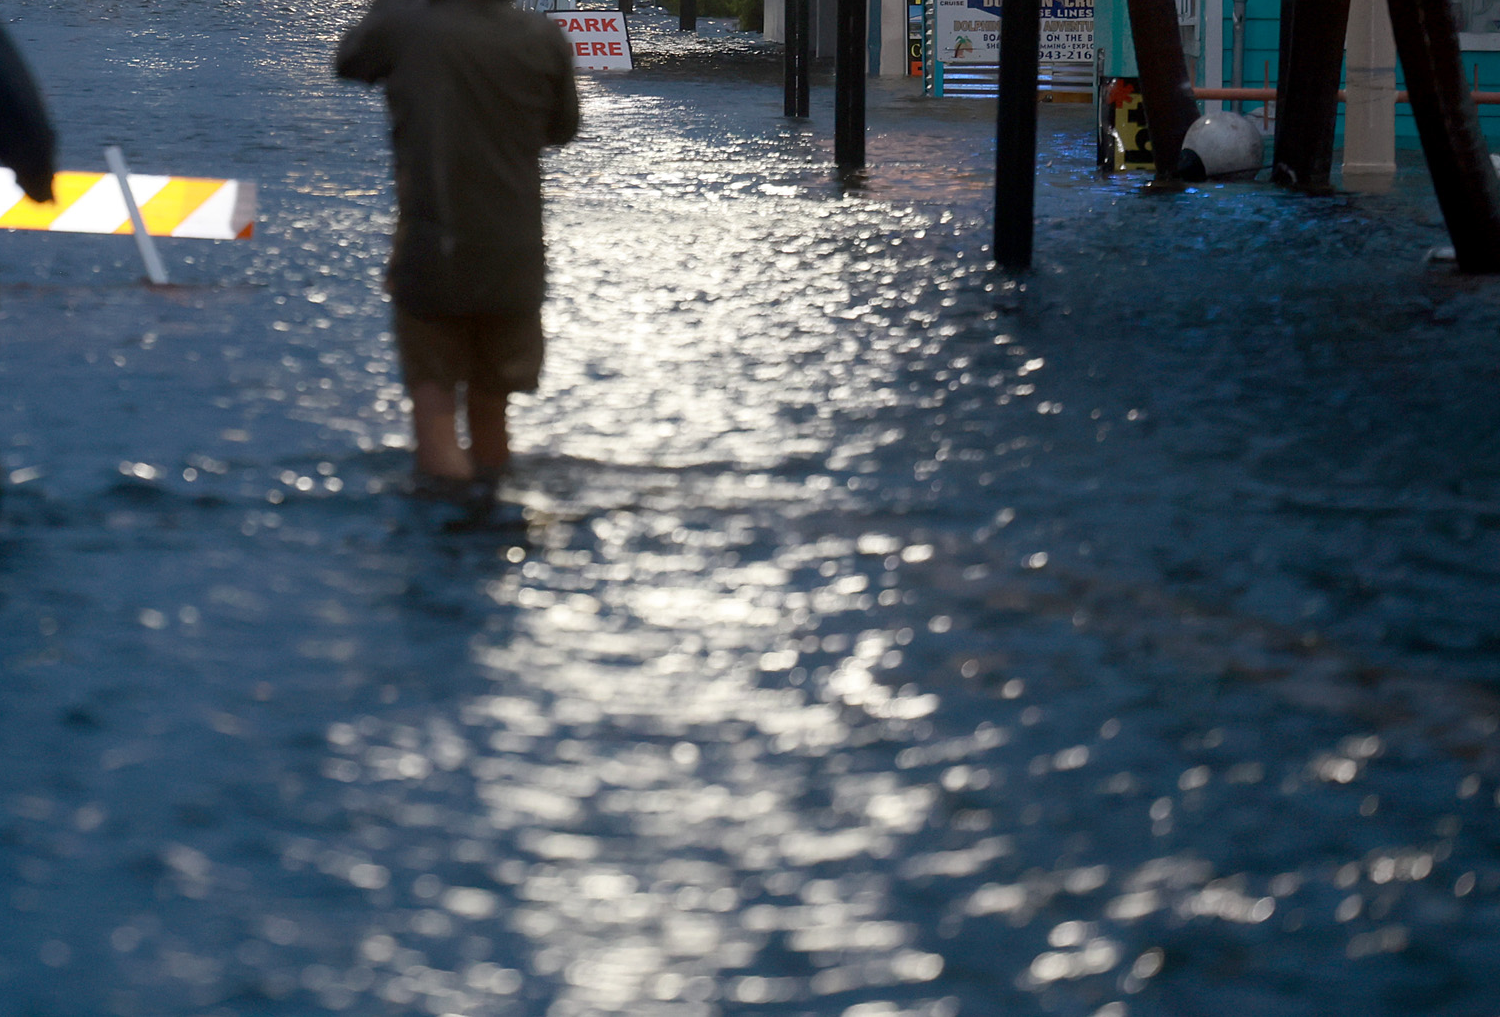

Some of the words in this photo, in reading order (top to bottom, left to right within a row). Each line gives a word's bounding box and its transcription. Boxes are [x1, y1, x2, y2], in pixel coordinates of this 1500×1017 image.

[1057, 9, 1092, 18] LINES
[1043, 21, 1093, 32] ADVENTU
[1047, 34, 1060, 42] ON
[1065, 34, 1082, 42] THE
[1038, 51, 1092, 60] 943-216
